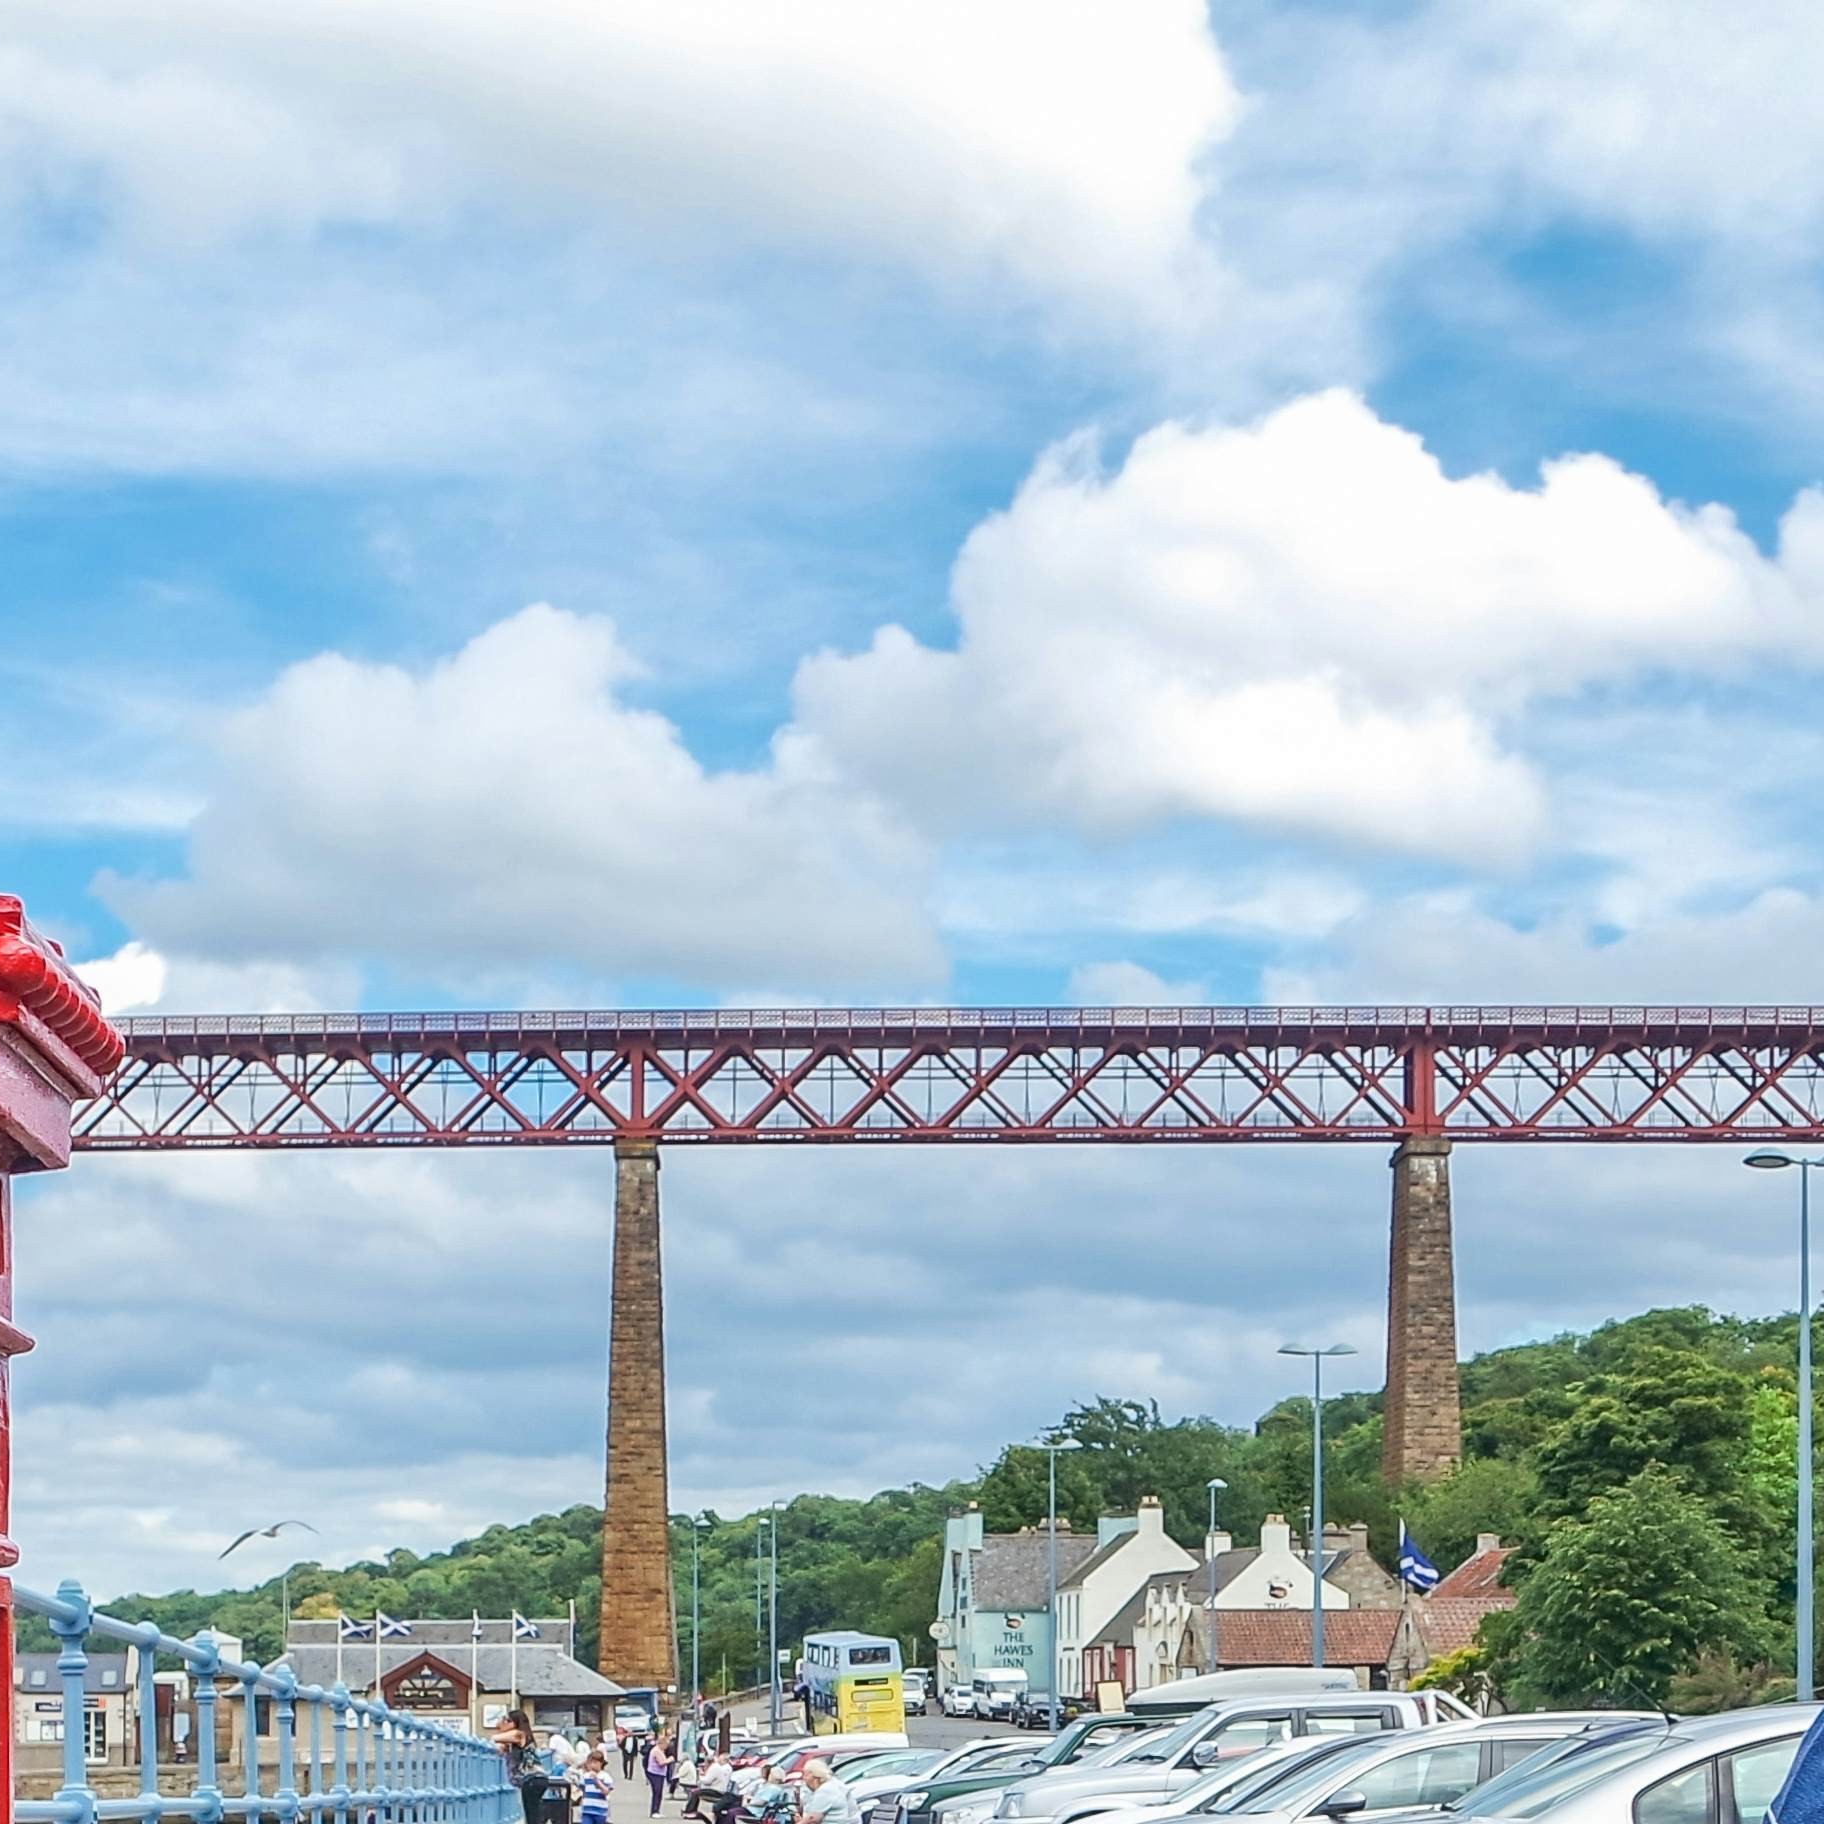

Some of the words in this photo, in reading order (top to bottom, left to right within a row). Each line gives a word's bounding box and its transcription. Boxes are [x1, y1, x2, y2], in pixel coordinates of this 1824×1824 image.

[1003, 1632, 1024, 1643] THE
[994, 1645, 1033, 1656] HAWES
[1002, 1658, 1024, 1669] INN
